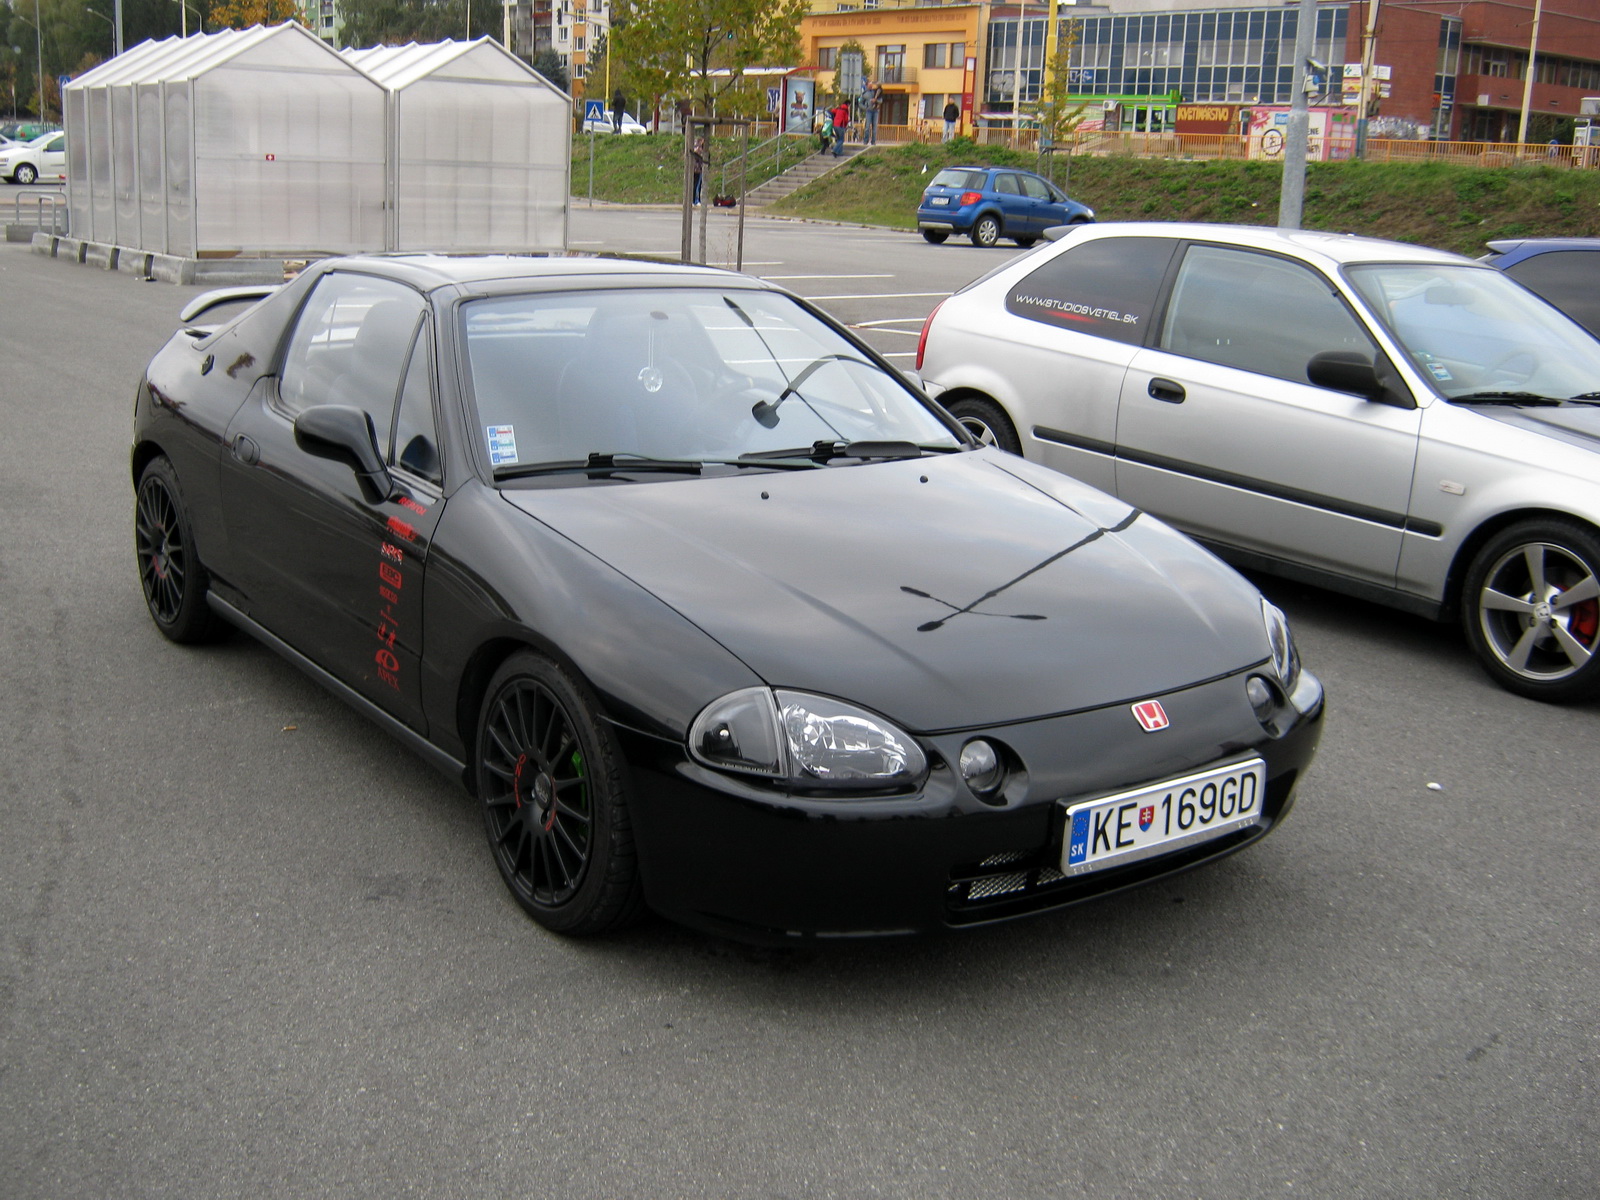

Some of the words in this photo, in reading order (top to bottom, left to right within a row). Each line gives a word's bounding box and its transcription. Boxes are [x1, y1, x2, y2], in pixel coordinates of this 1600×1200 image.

[1015, 294, 1139, 325] WWW.STUDIOSVETIEL.SK
[1092, 802, 1138, 854] KE
[1161, 771, 1257, 835] 169GD
[1070, 842, 1085, 857] SK
